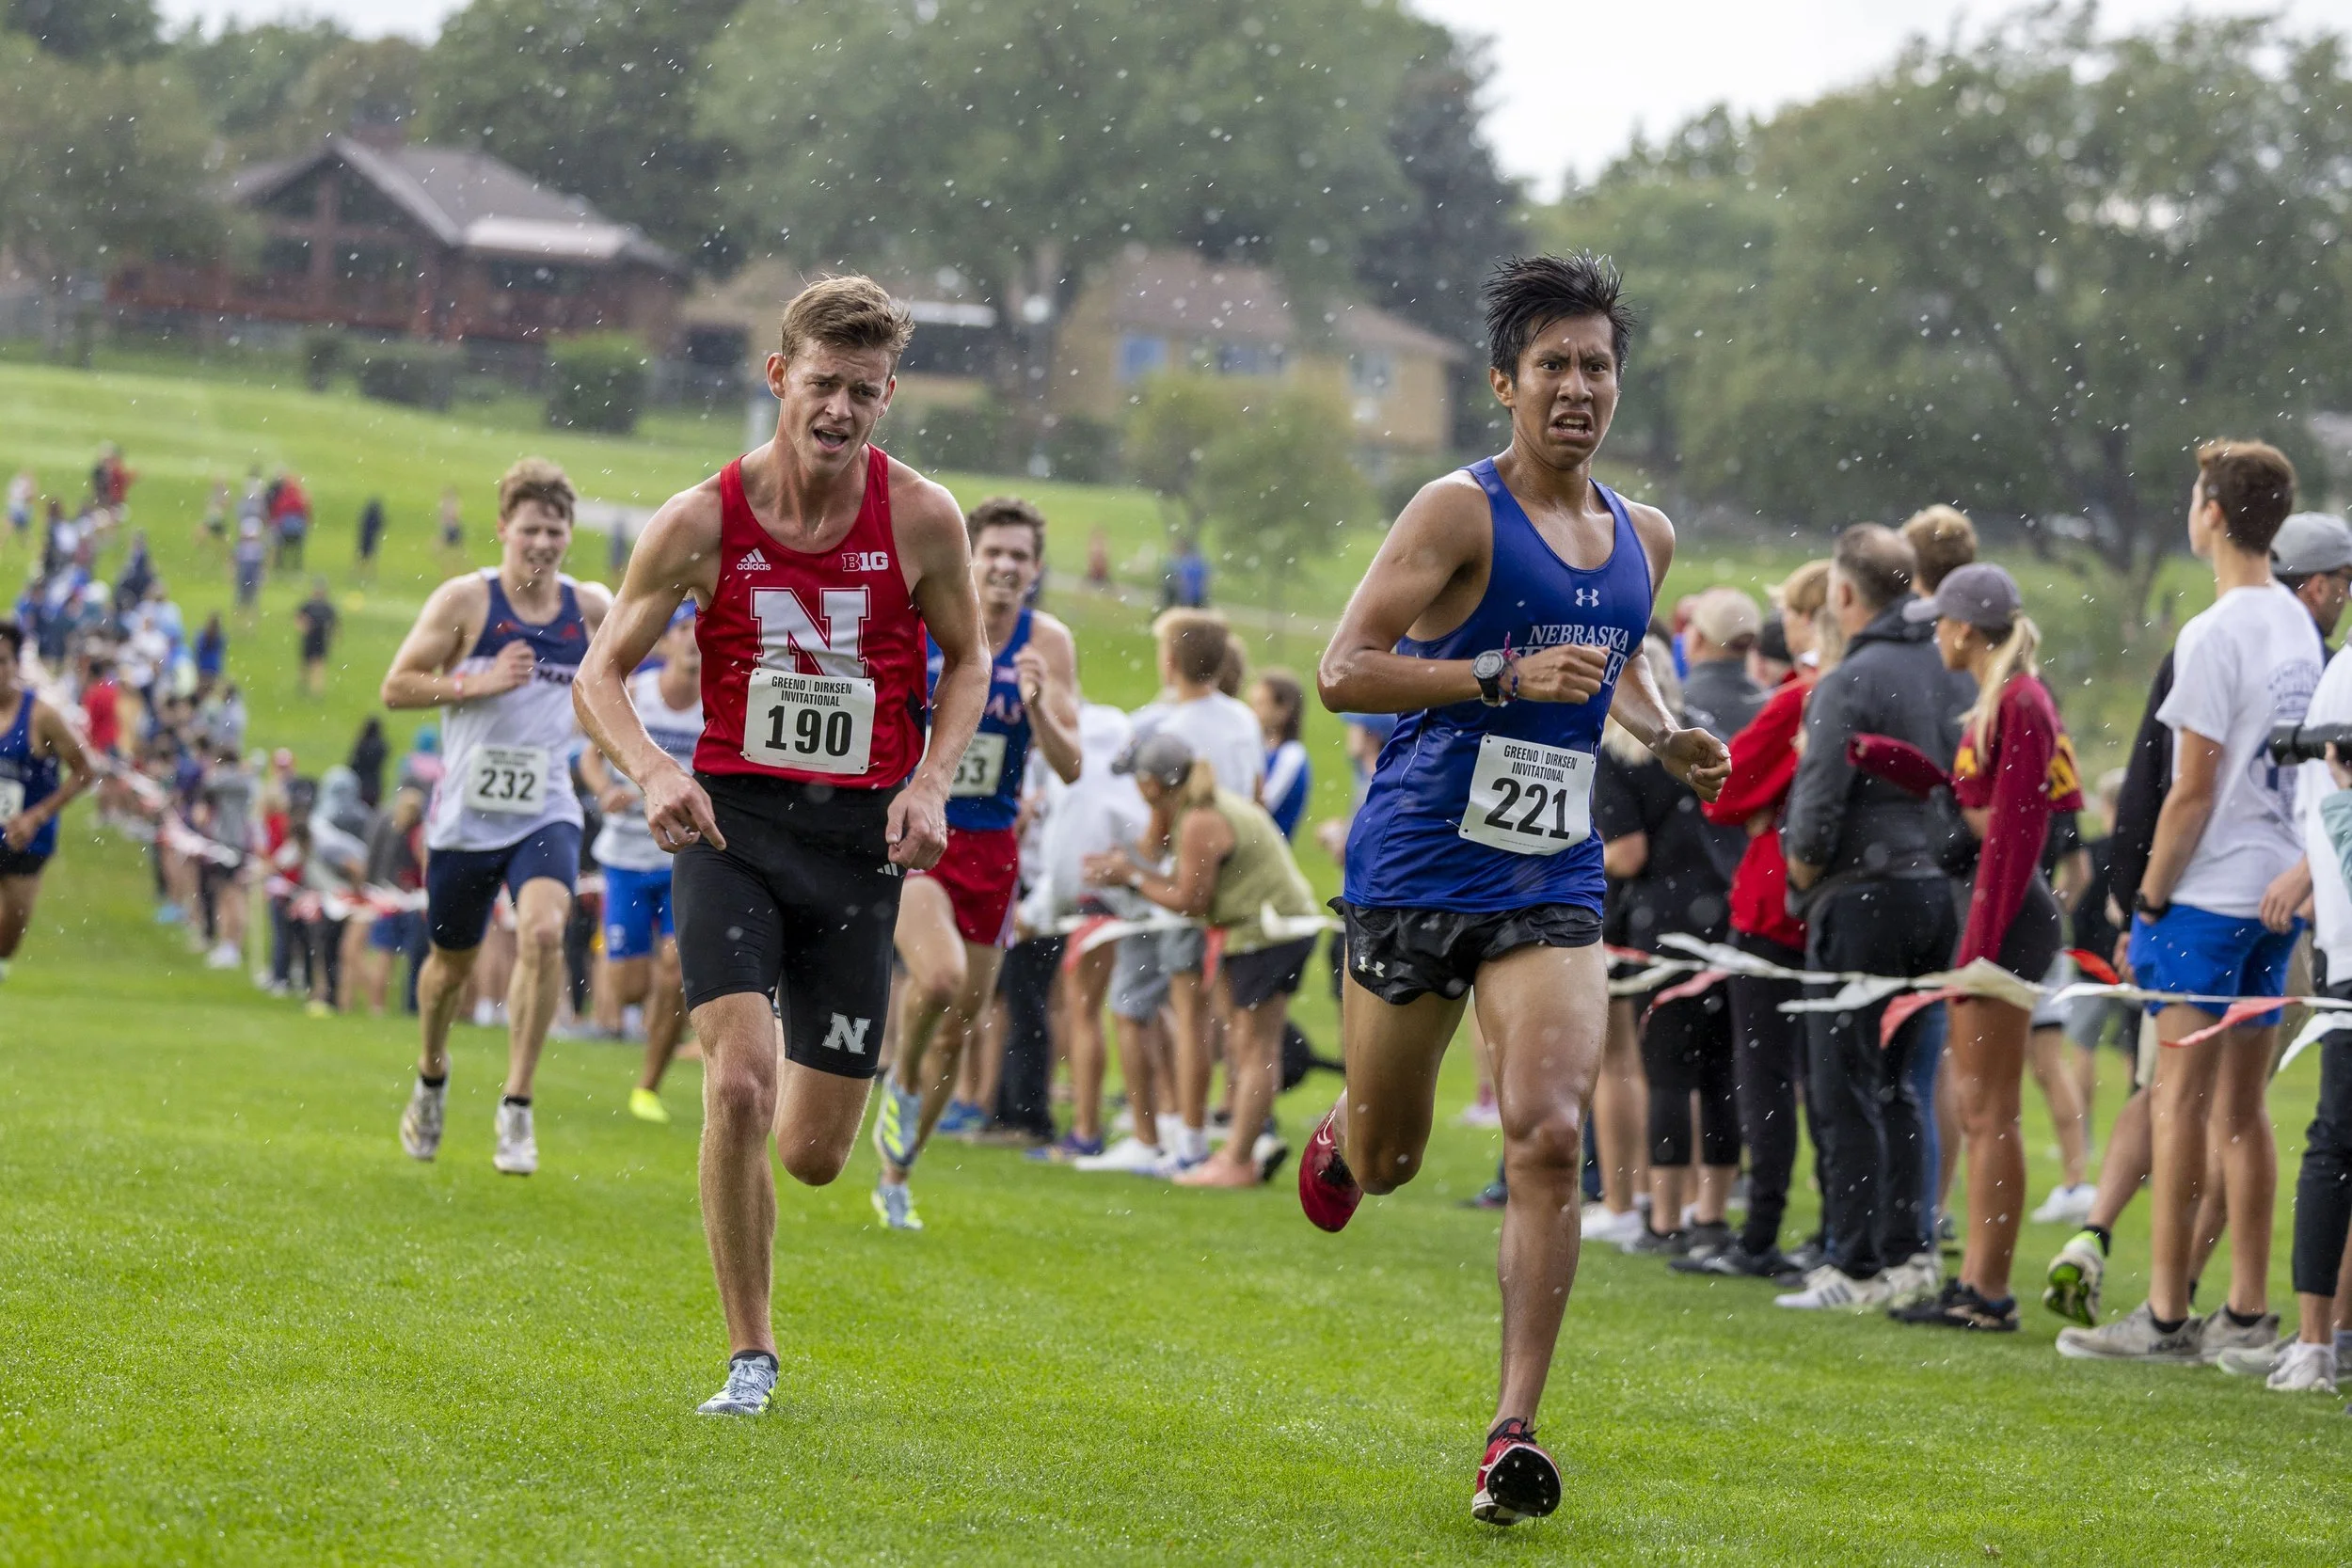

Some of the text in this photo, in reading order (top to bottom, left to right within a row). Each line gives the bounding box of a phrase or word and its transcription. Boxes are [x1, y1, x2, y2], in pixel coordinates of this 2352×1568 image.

[737, 562, 771, 571] adidas
[751, 587, 870, 675] N
[1526, 625, 1629, 652] NEBRASKA
[771, 675, 852, 694] GREENO DIRKSEN
[781, 689, 841, 706] INVITATIONAL
[765, 705, 852, 756] 190
[1503, 744, 1578, 769] GREENO DIRKSEN
[479, 768, 535, 800] 232
[1511, 761, 1565, 783] INVITATIONAL
[1484, 777, 1570, 840] 221
[822, 1012, 871, 1054] N
